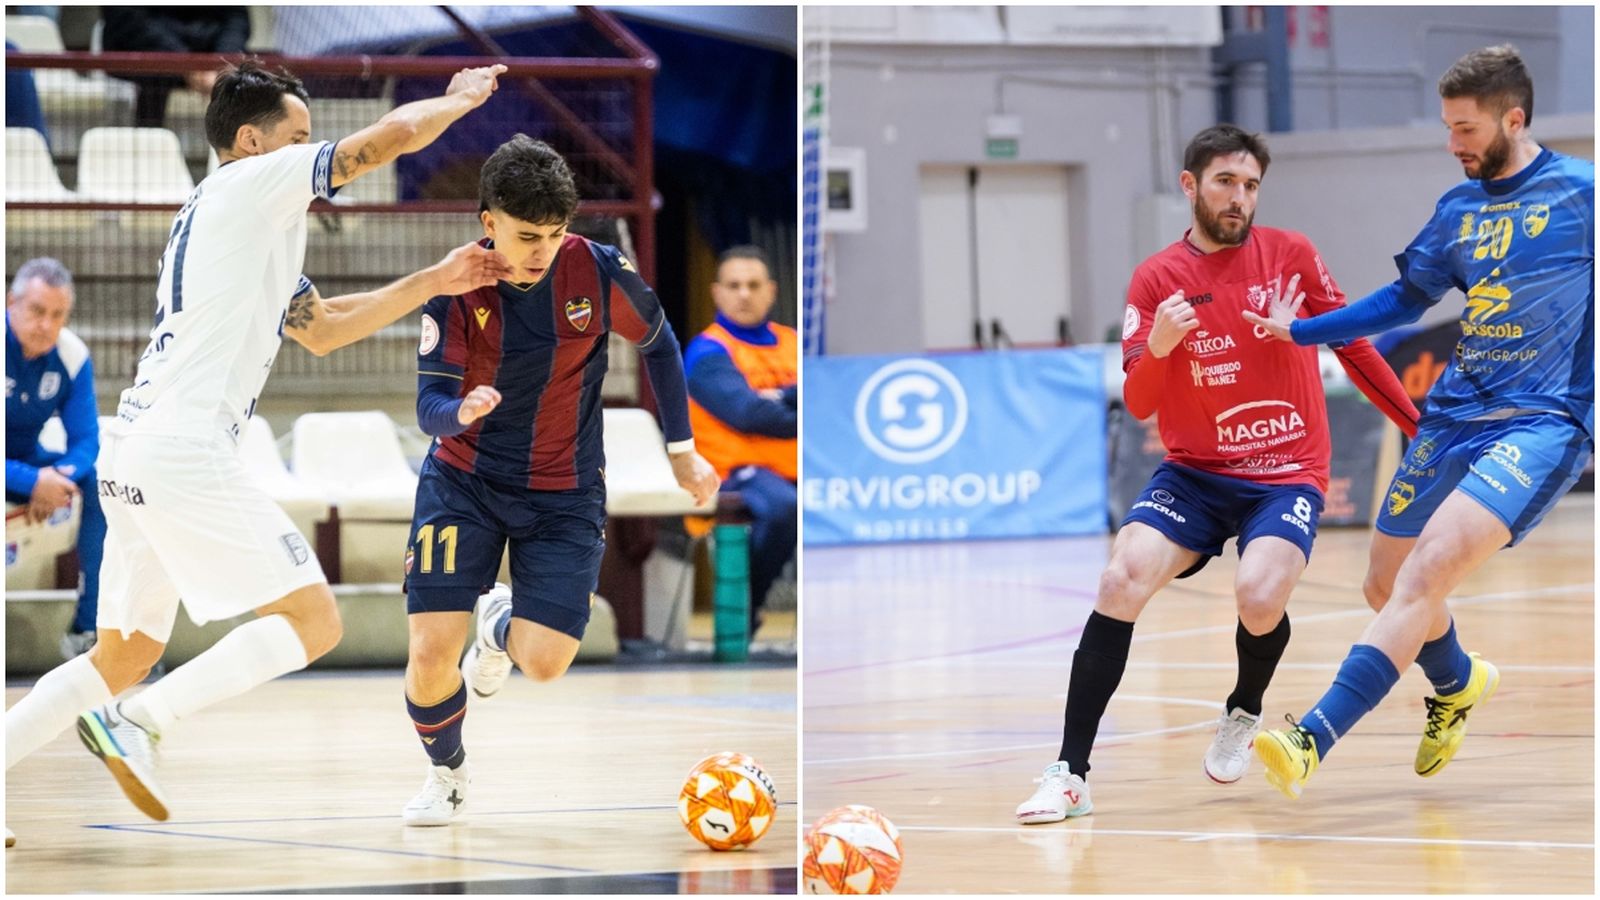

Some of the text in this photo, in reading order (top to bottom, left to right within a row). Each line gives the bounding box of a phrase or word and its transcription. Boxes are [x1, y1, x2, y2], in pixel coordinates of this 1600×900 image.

[1474, 217, 1513, 260] 20
[1217, 411, 1305, 443] MAGNA
[1293, 496, 1312, 523] 8
[416, 524, 458, 574] 11
